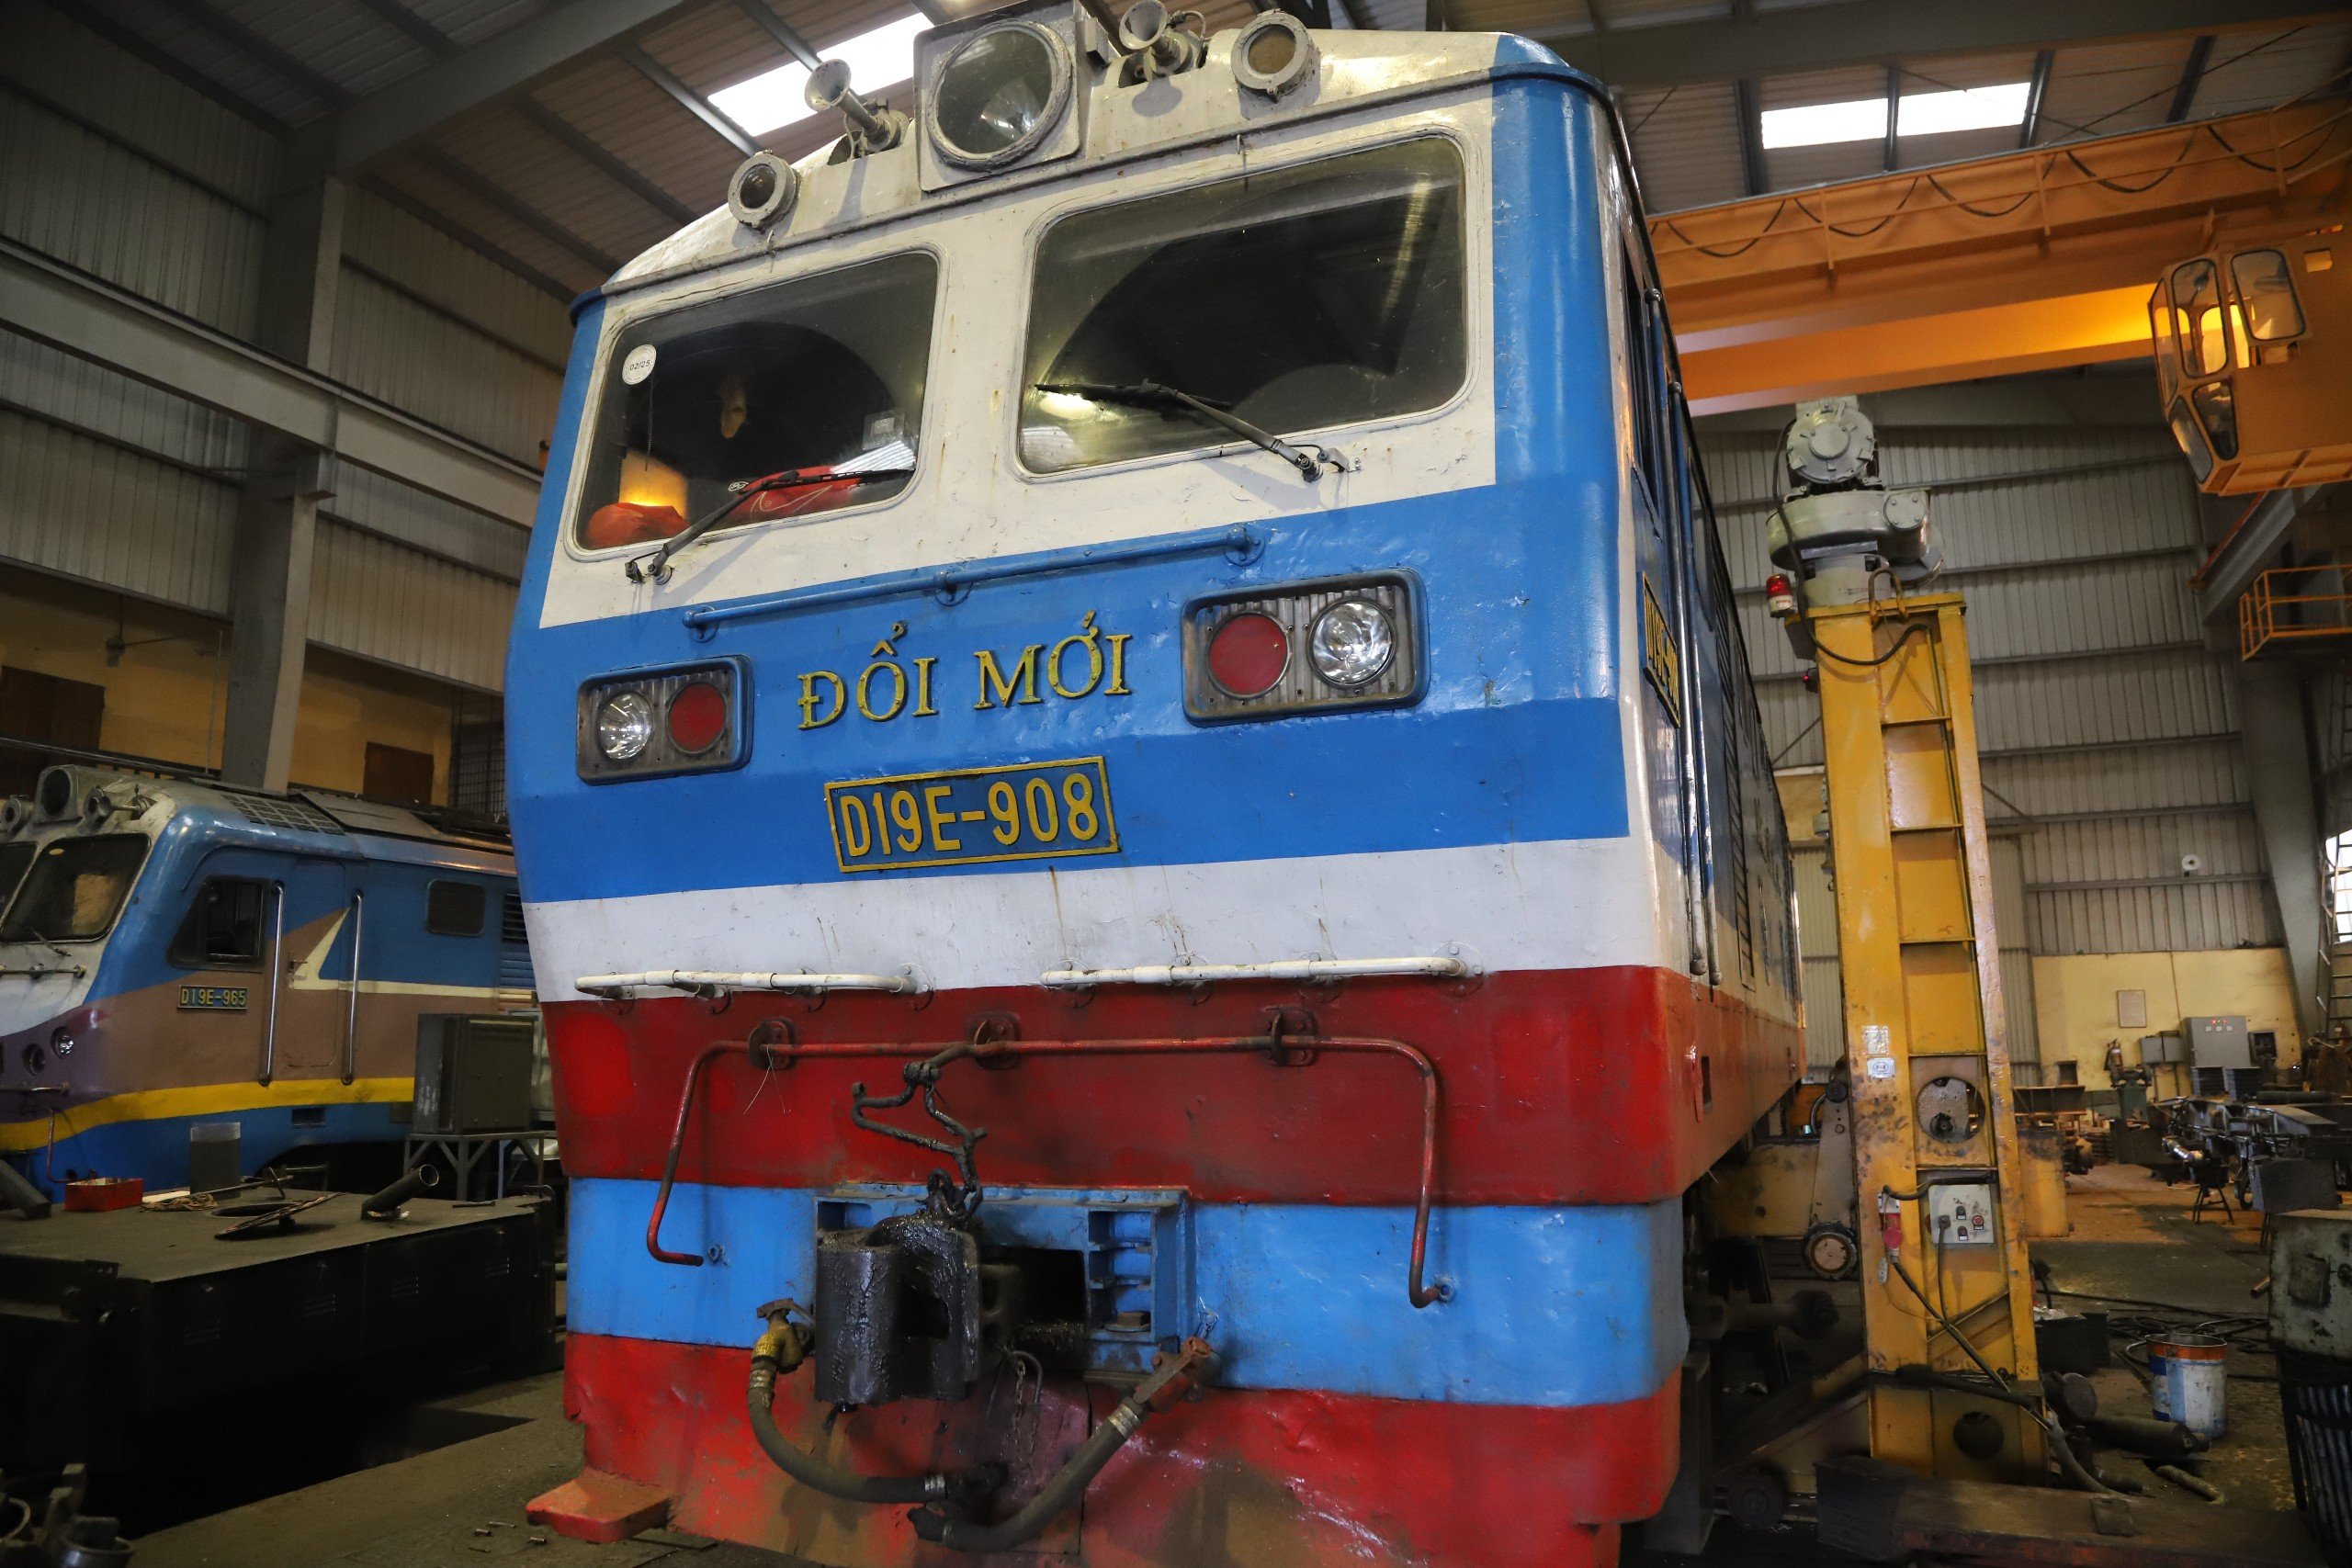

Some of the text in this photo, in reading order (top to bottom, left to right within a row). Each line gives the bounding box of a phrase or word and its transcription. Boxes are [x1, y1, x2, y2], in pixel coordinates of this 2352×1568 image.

[797, 609, 1133, 729] ĐỔI MỚI
[1645, 592, 1679, 715] D19E-
[840, 773, 1100, 856] D19E-908
[181, 988, 246, 1006] D19E-965
